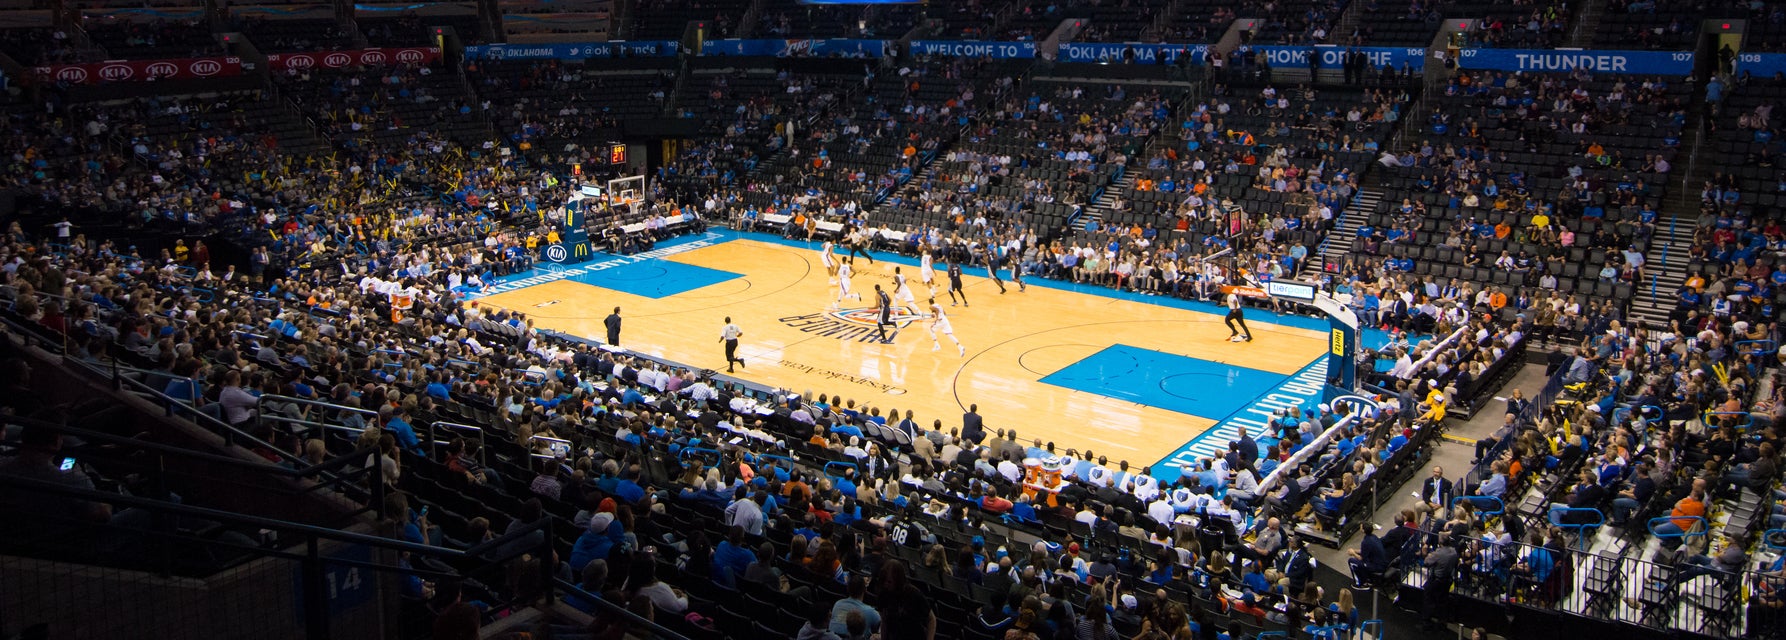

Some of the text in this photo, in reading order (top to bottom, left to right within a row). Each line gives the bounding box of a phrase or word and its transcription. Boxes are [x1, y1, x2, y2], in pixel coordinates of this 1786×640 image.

[507, 47, 554, 57] OKLAHOMA
[926, 44, 1017, 57] WELCOME TO
[1407, 48, 1423, 56] 106
[1461, 49, 1477, 58] 107
[328, 56, 345, 65] KIA
[365, 53, 382, 62] KIA
[401, 52, 419, 61] KIA
[1358, 52, 1391, 67] HE
[1672, 53, 1692, 61] 107
[1740, 54, 1761, 63] 108
[290, 57, 310, 67] KIA
[1515, 53, 1627, 71] THUNDER
[105, 67, 127, 78] KIA
[151, 65, 171, 75] KIA
[195, 63, 216, 73] KIA
[62, 71, 82, 80] KIA
[613, 152, 623, 162] 21
[550, 246, 563, 259] KIA
[1273, 284, 1311, 297] tierpoint
[779, 312, 899, 344] THUNDER
[1334, 331, 1342, 352] Hertz
[892, 525, 908, 545] 08
